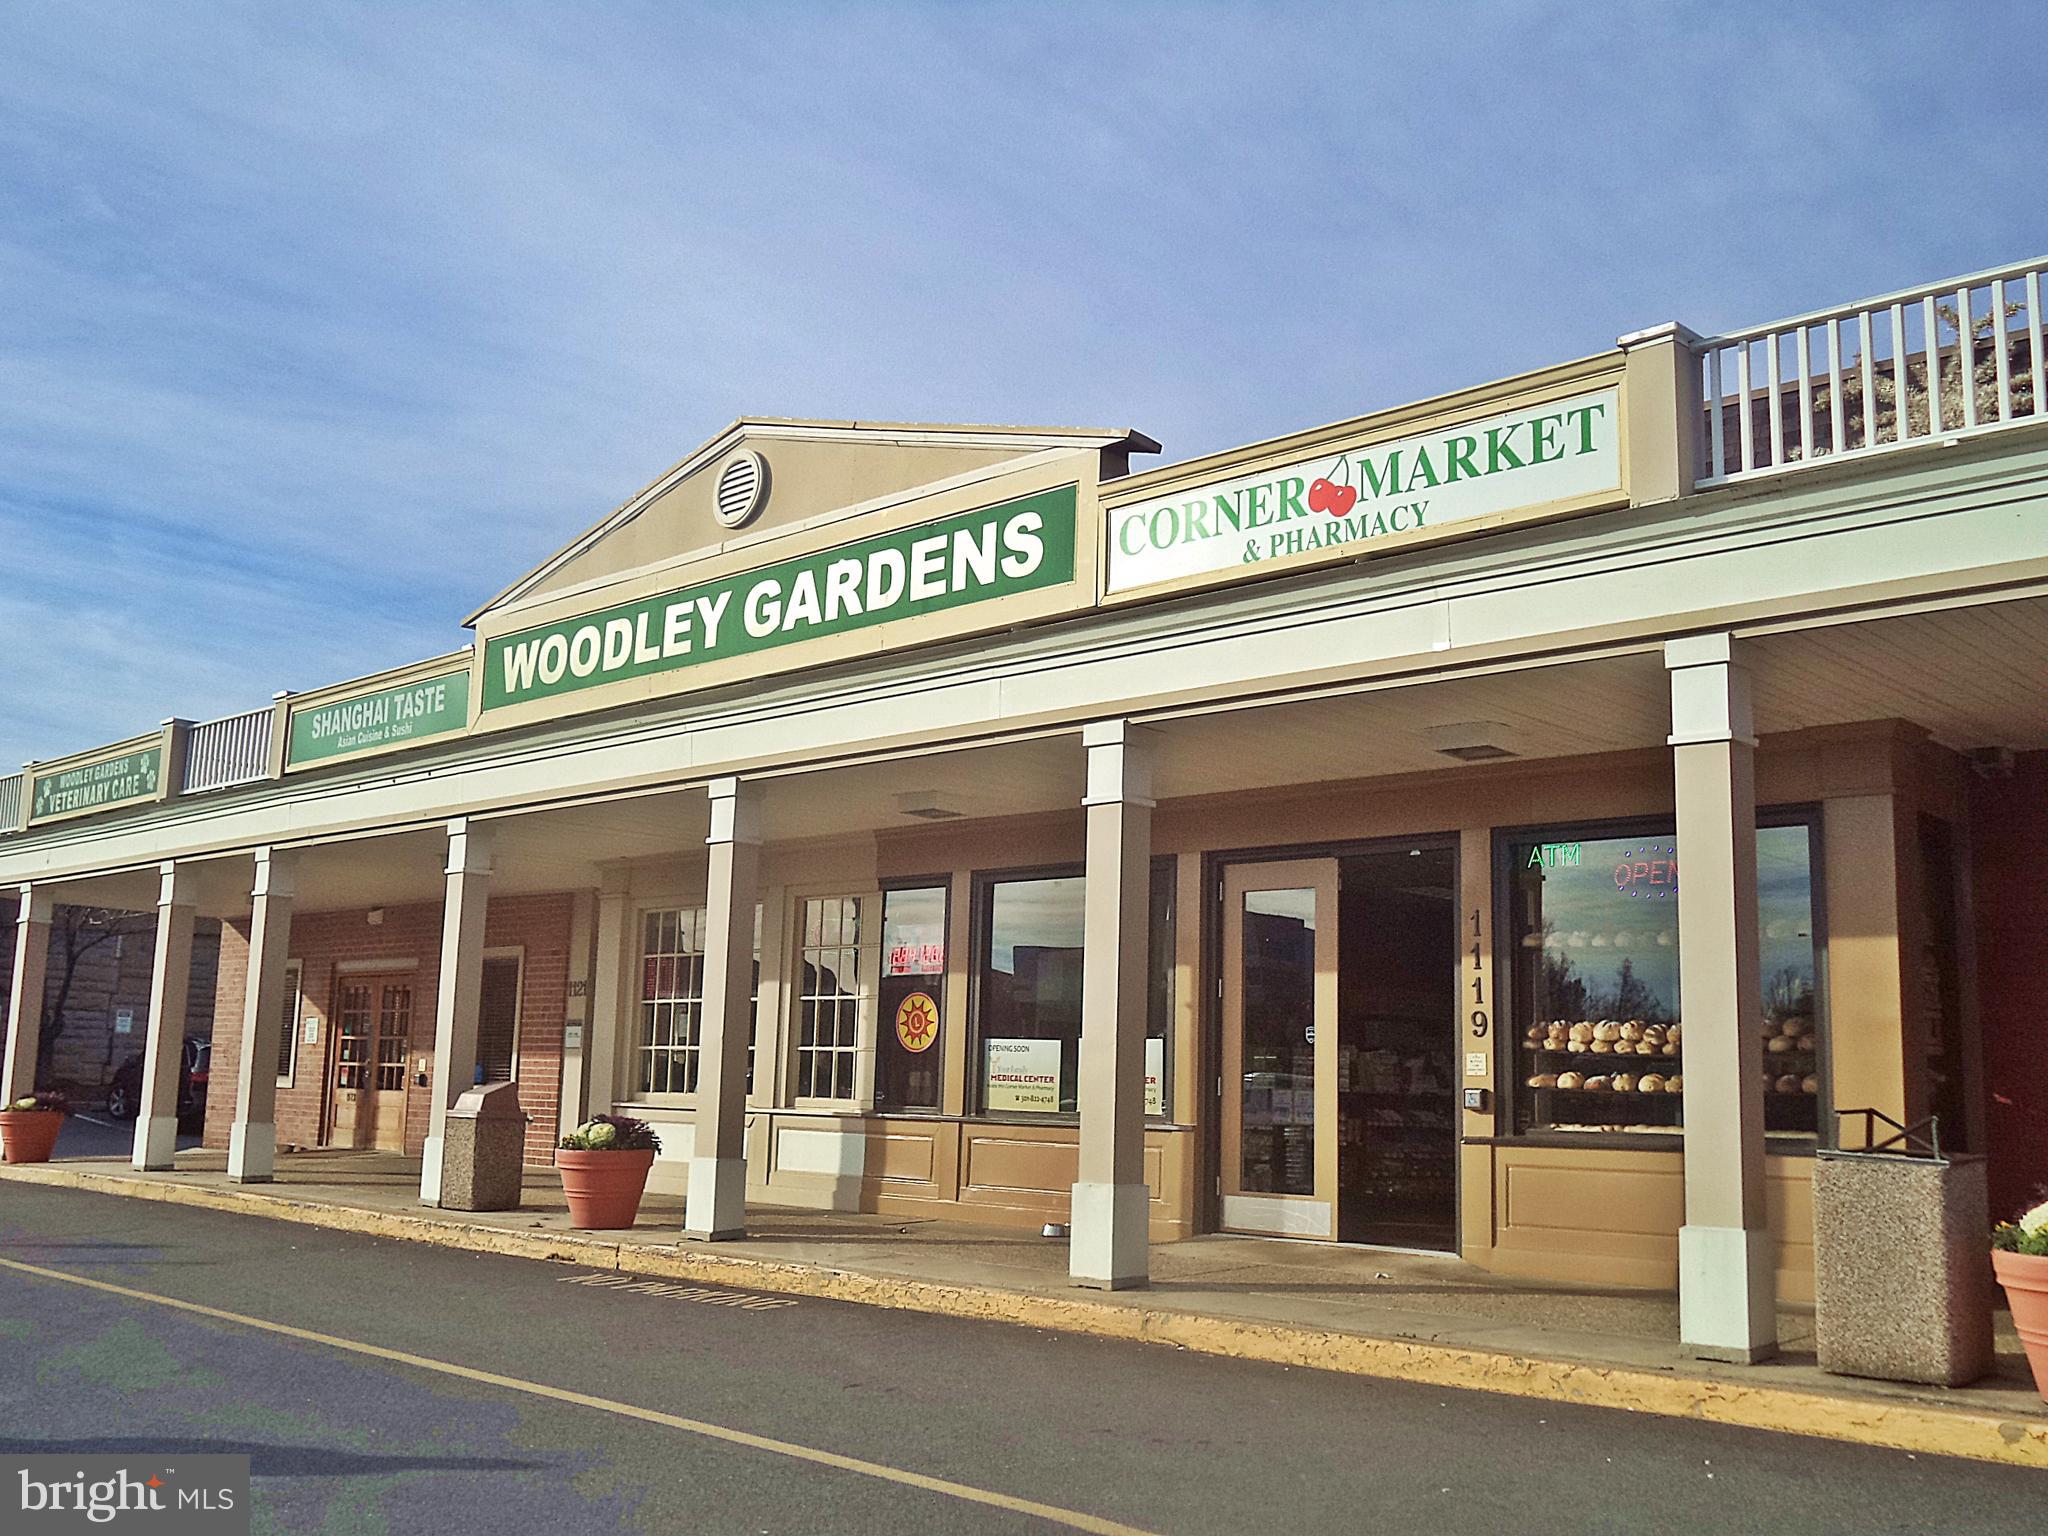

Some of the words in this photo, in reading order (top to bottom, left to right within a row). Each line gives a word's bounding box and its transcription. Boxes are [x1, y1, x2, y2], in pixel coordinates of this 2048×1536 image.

[1119, 476, 1308, 556] CORNER
[1356, 404, 1605, 504] MARKET
[1242, 538, 1261, 564] &
[1270, 500, 1430, 558] PHARMACY
[503, 590, 732, 694] WOODLEY
[743, 511, 1044, 639] GARDENS
[311, 697, 389, 739] SHANGHAI
[393, 683, 446, 721] TASTE
[337, 735, 356, 749] Asian
[357, 729, 383, 745] Cuisine
[384, 726, 389, 739] &
[391, 721, 413, 737] Sushi
[95, 758, 129, 780] GARDENS
[49, 781, 110, 813] VETERINARY
[112, 774, 140, 800] CARE
[1527, 843, 1582, 869] ATM
[1470, 909, 1488, 1038] 1119
[988, 1044, 1013, 1052] OPENING
[1013, 1045, 1030, 1053] SOON
[991, 1074, 1023, 1083] MEDICAL
[1024, 1075, 1055, 1084] CENTER
